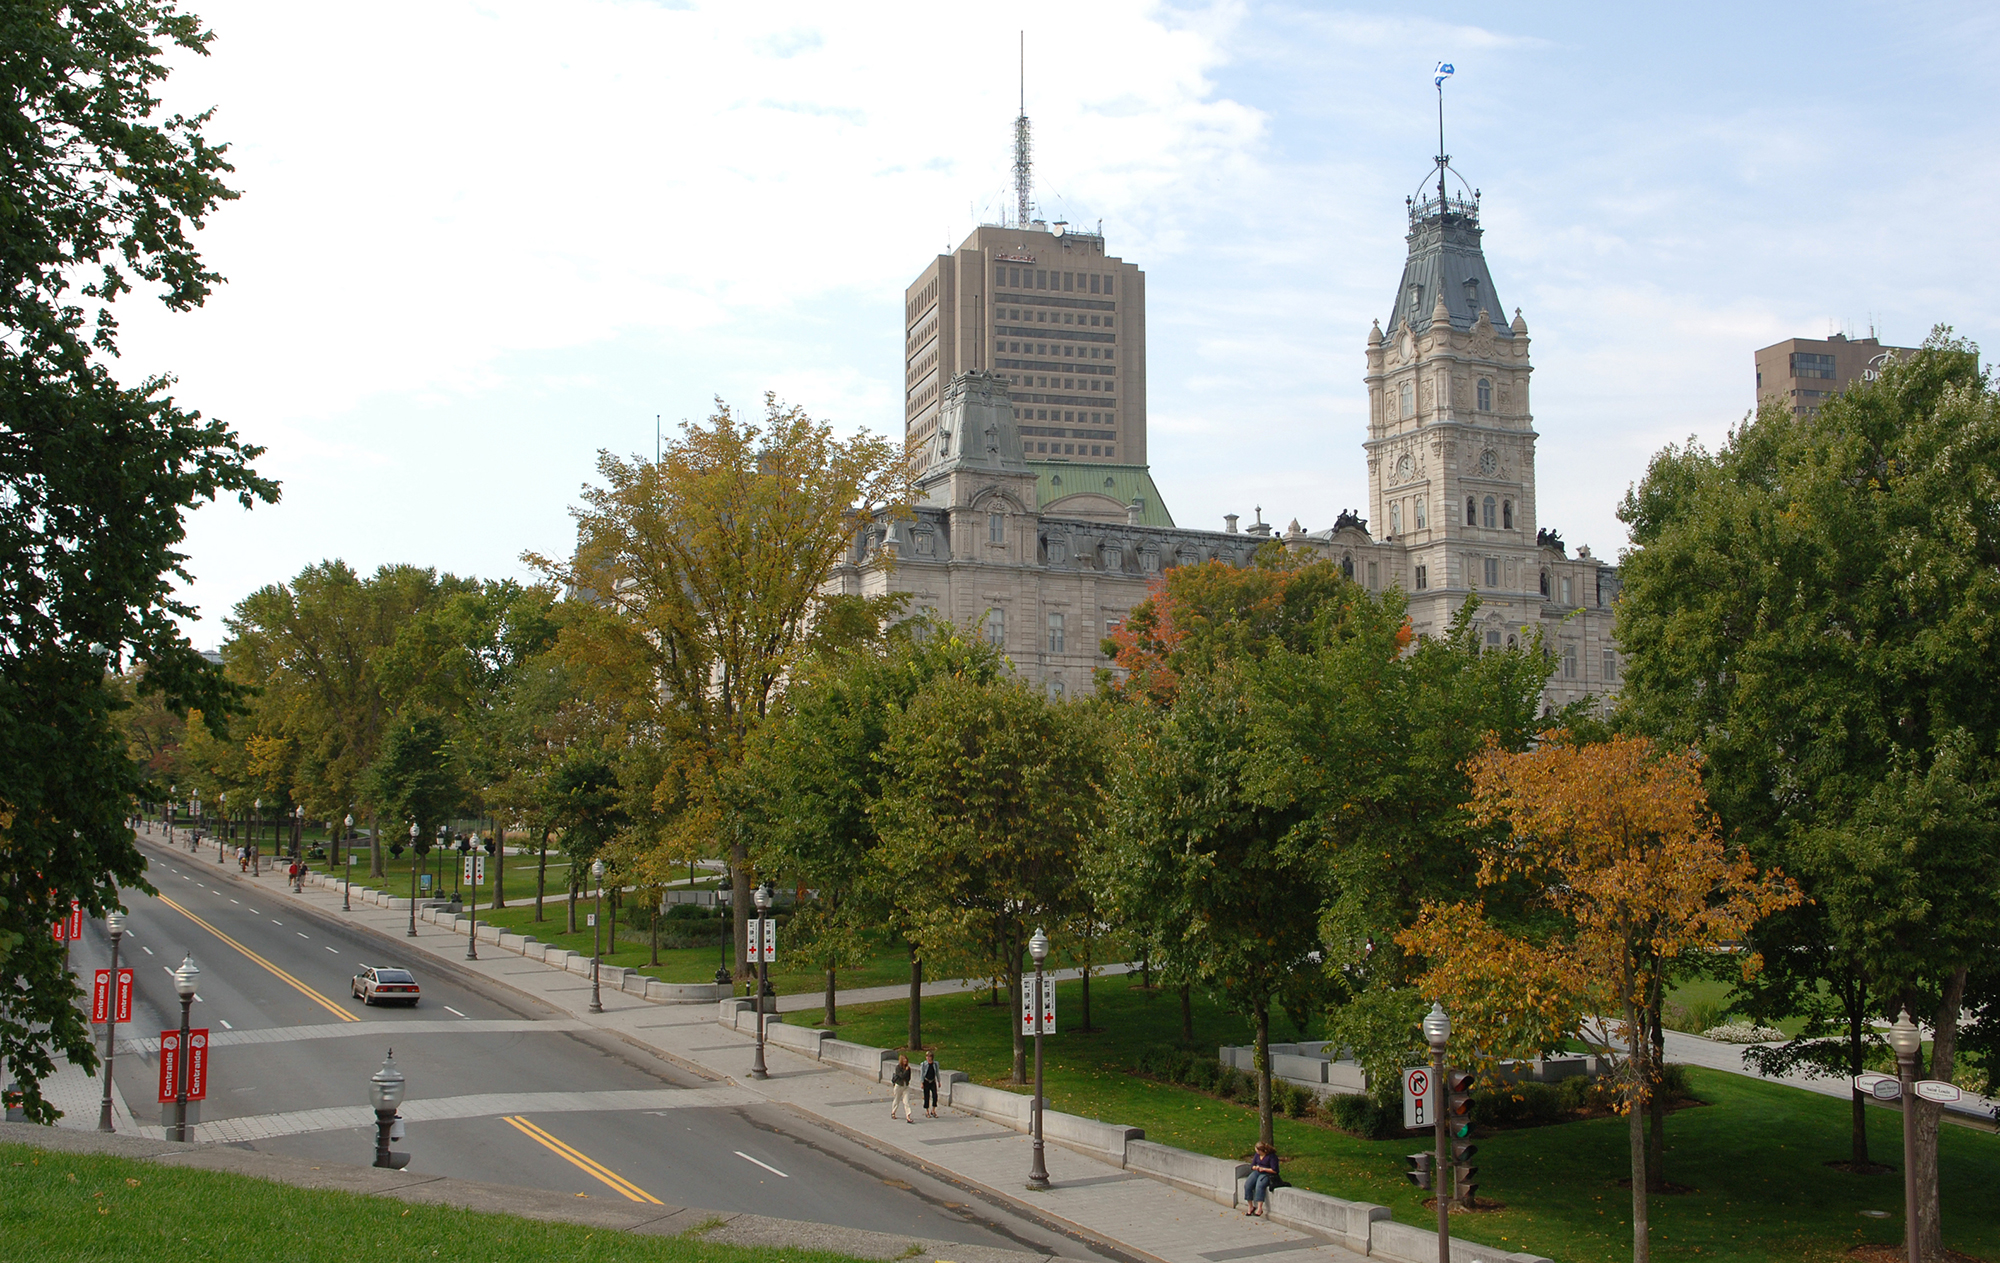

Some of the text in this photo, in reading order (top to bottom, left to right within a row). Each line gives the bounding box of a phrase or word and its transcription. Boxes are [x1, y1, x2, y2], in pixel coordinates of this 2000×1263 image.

[97, 985, 105, 1019] Centraide
[120, 984, 128, 1019] Centraide
[164, 1051, 174, 1097] Centraide
[192, 1050, 202, 1095] Centraide
